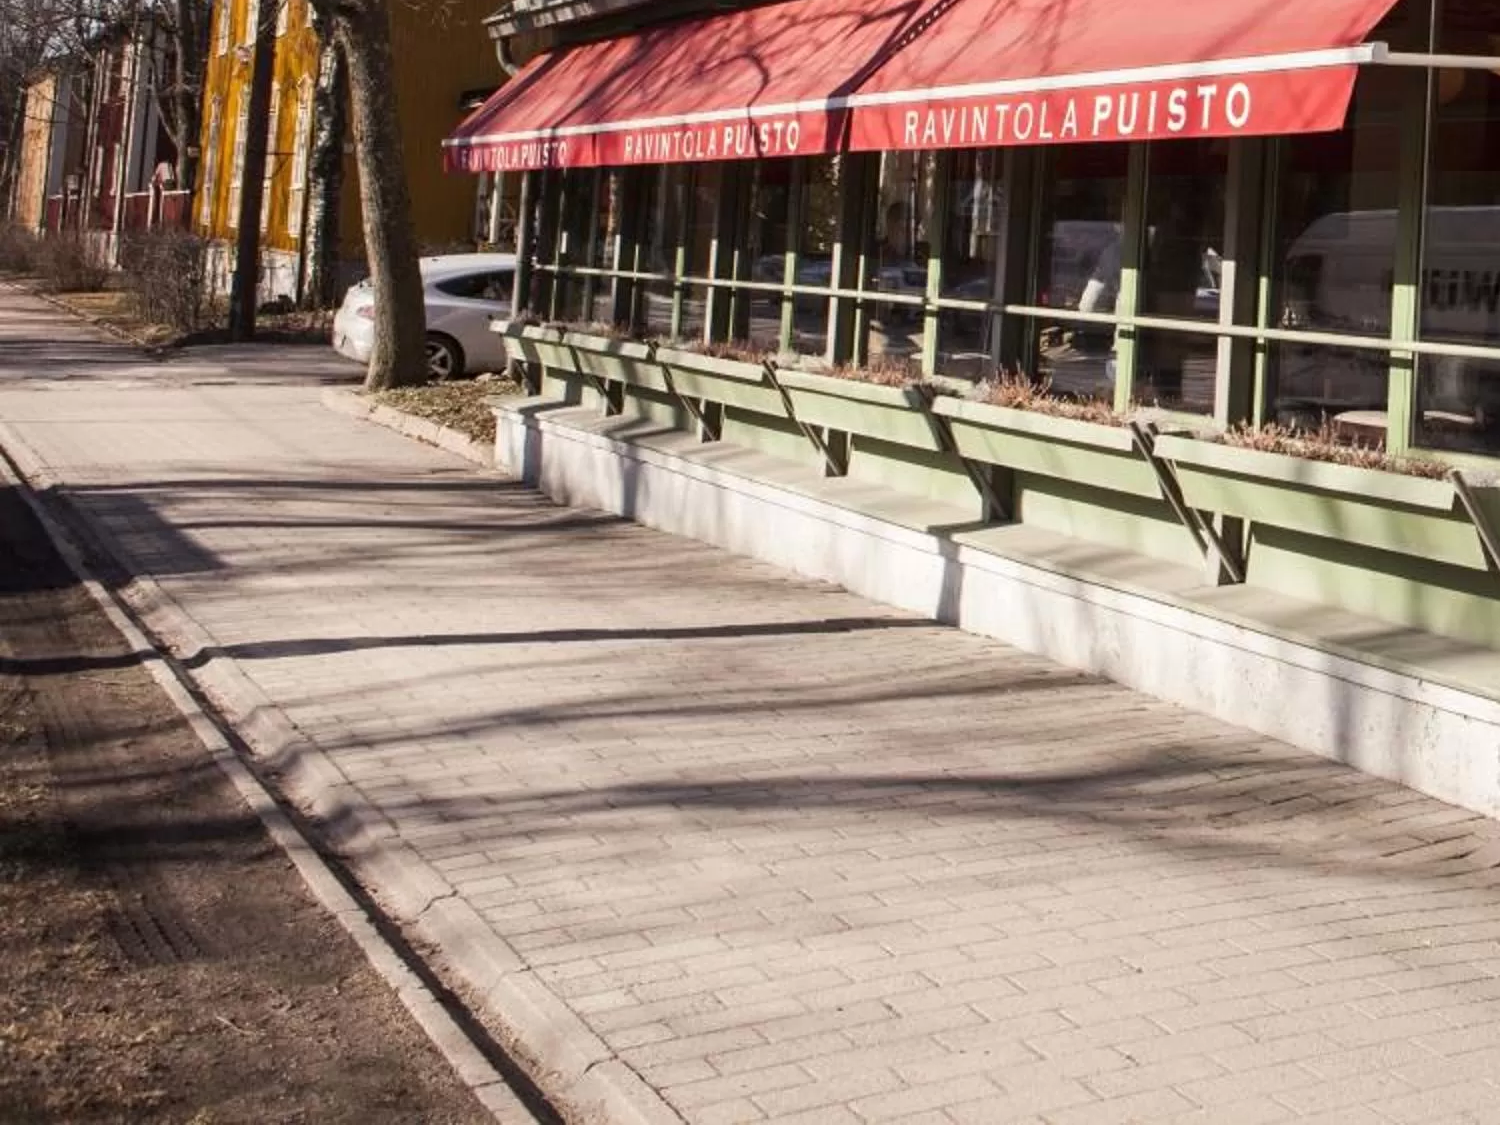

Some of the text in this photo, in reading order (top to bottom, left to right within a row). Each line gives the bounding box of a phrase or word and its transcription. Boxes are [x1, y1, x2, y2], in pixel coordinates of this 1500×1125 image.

[904, 82, 1251, 145] RAVINTOLA PUISTO
[521, 141, 567, 168] PUISTO
[624, 120, 800, 161] RAVINTOLA PUISTO
